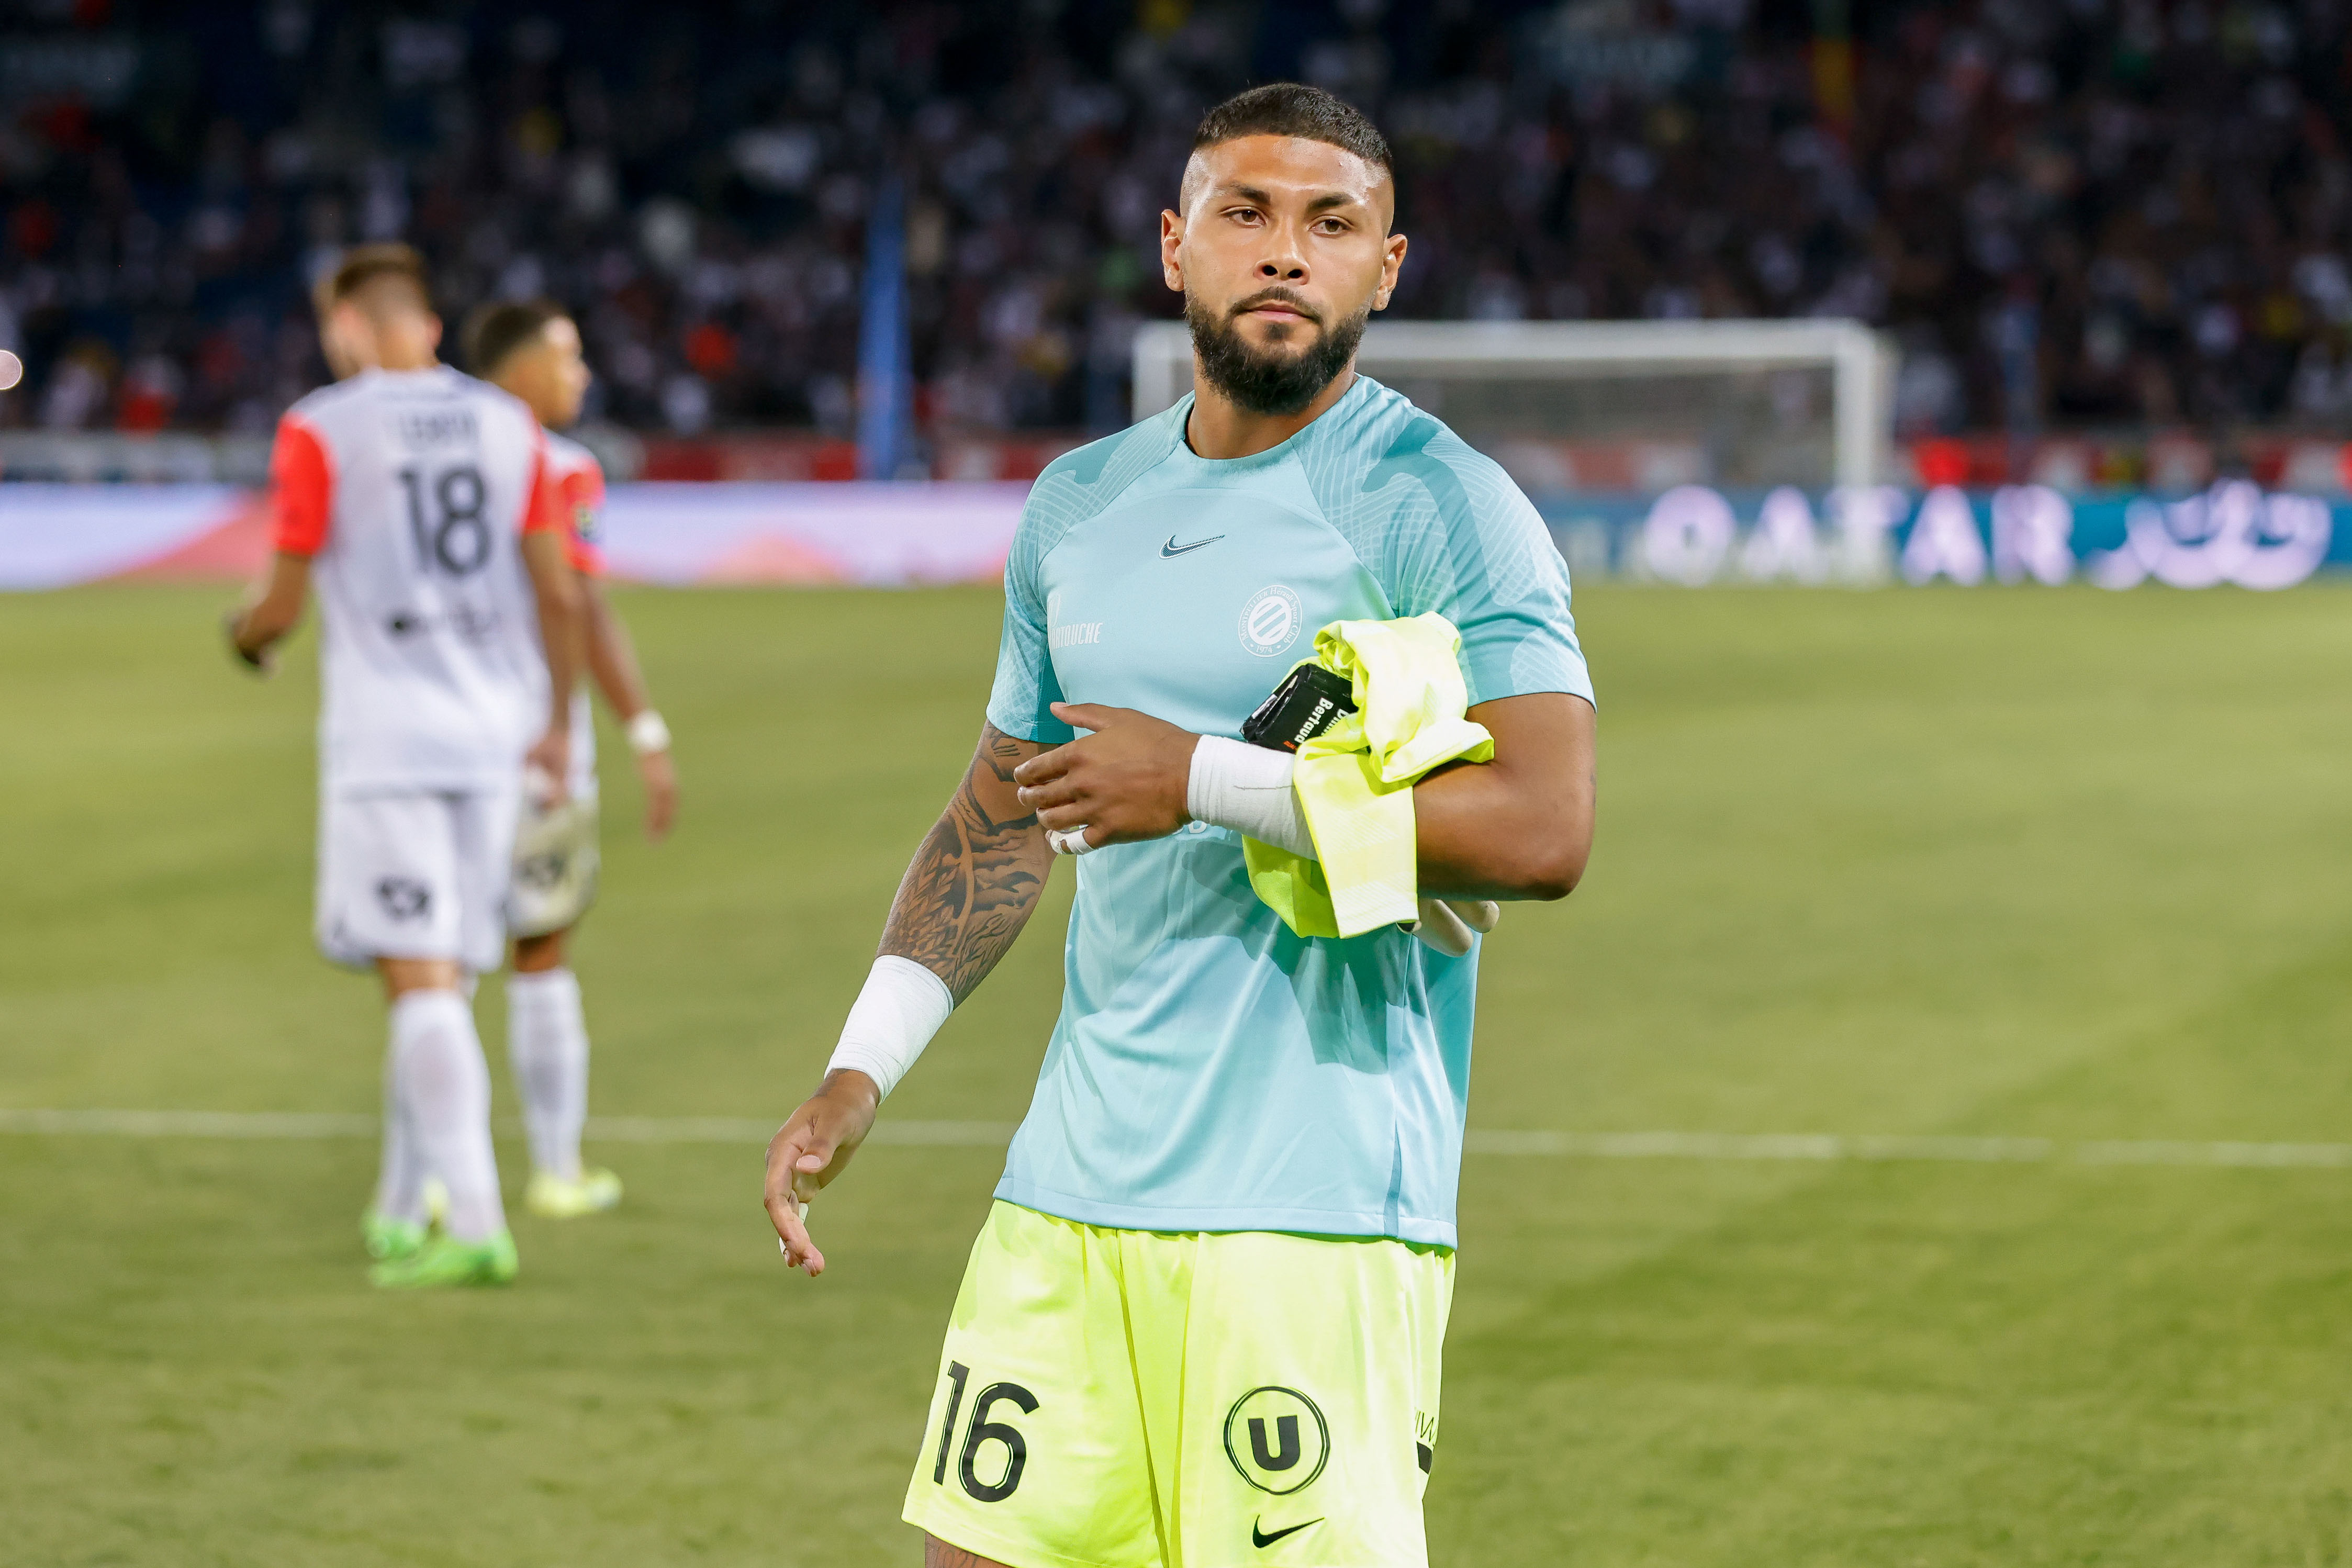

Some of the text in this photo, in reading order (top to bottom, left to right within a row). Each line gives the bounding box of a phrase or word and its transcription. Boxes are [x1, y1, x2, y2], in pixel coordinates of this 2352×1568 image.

[399, 465, 491, 579] 18
[1645, 484, 2077, 586] QATAR
[1048, 622, 1103, 651] ARTOUCHE
[1256, 645, 1273, 654] 1974
[934, 1360, 1040, 1502] 16
[1248, 1415, 1301, 1471] U
